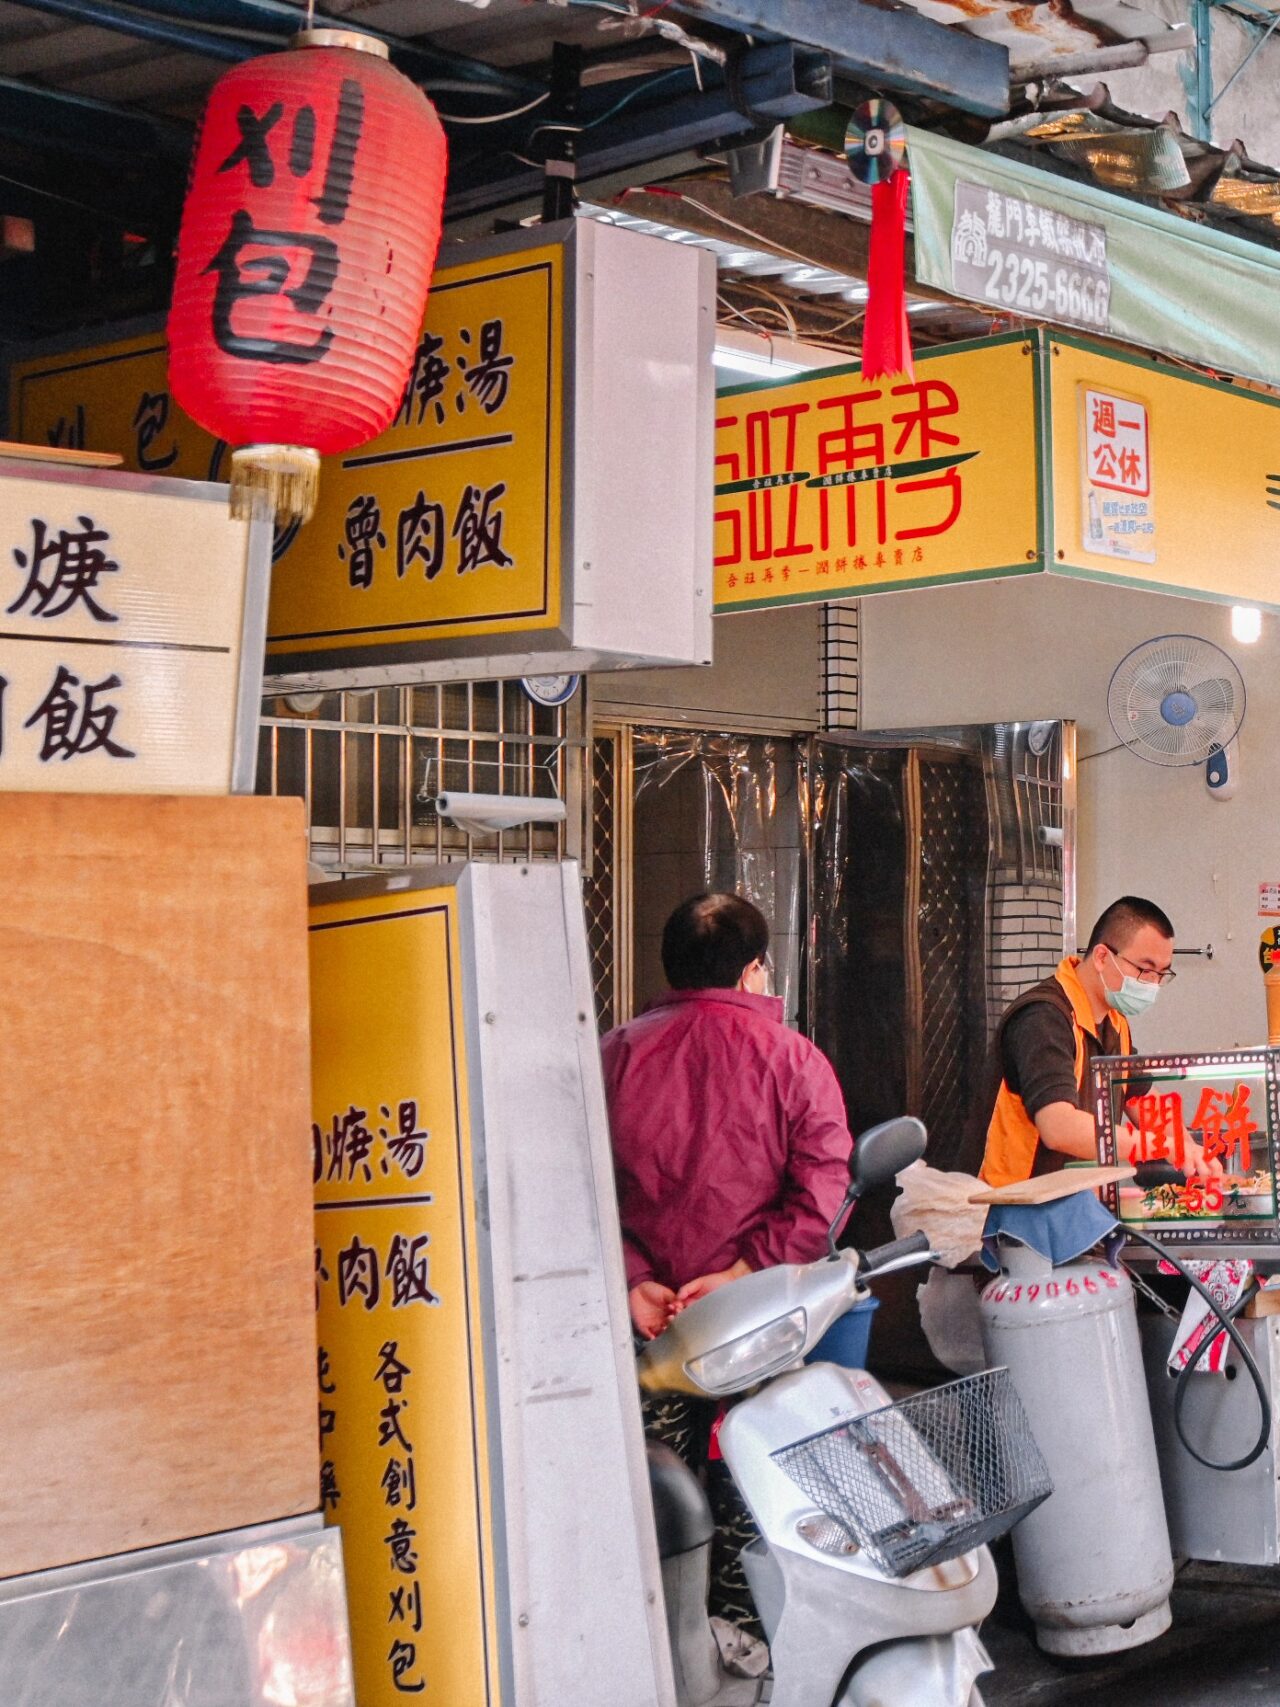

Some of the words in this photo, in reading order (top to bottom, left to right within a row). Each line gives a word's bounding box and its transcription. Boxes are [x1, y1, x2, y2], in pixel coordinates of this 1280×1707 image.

[203, 79, 364, 364] 刈包
[985, 250, 1108, 326] 2325-6666
[1092, 397, 1142, 438] 週一
[1092, 443, 1142, 486] 公休
[337, 482, 514, 589] 魯肉飯
[0, 664, 137, 762] 飯
[1126, 1083, 1259, 1172] 潤餅
[374, 1340, 426, 1693] 各式創意刈包
